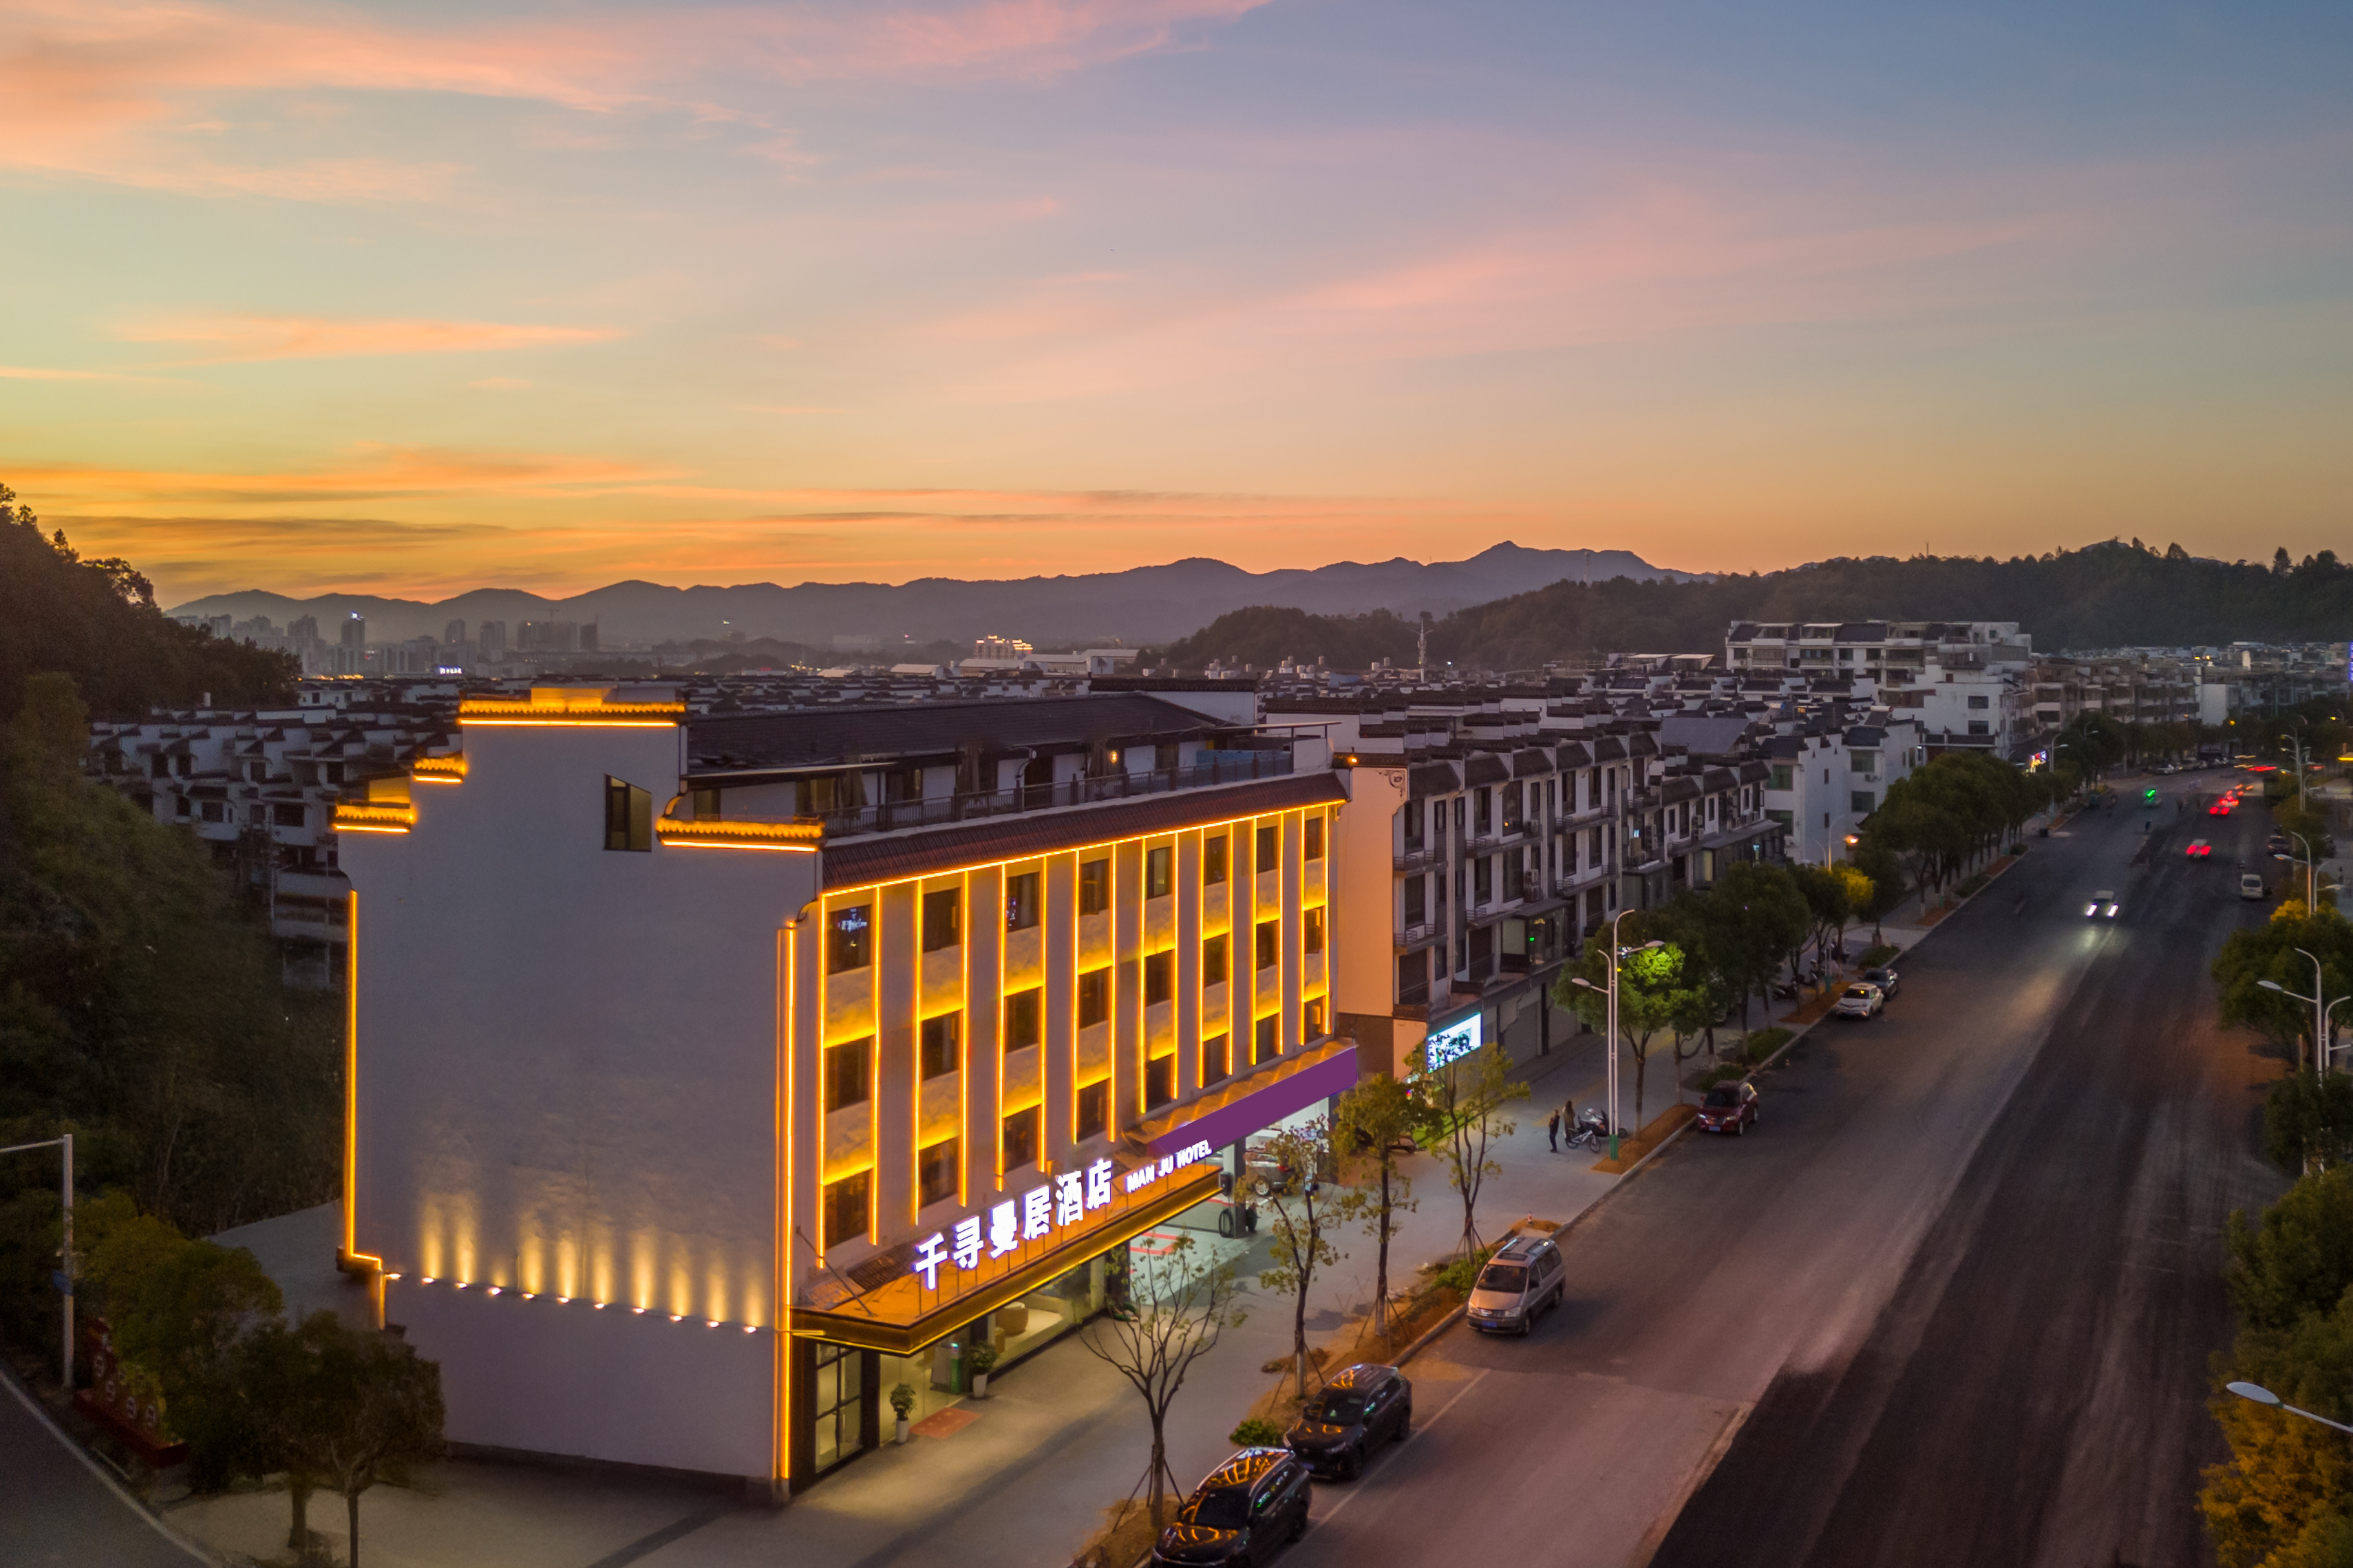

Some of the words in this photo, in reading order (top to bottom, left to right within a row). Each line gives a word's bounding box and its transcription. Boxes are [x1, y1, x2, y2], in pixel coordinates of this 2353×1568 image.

[1126, 1163, 1156, 1194] MAN
[1158, 1154, 1174, 1177] JU
[1175, 1139, 1213, 1169] HOTEL
[913, 1158, 1113, 1290] 千寻曼居酒店
